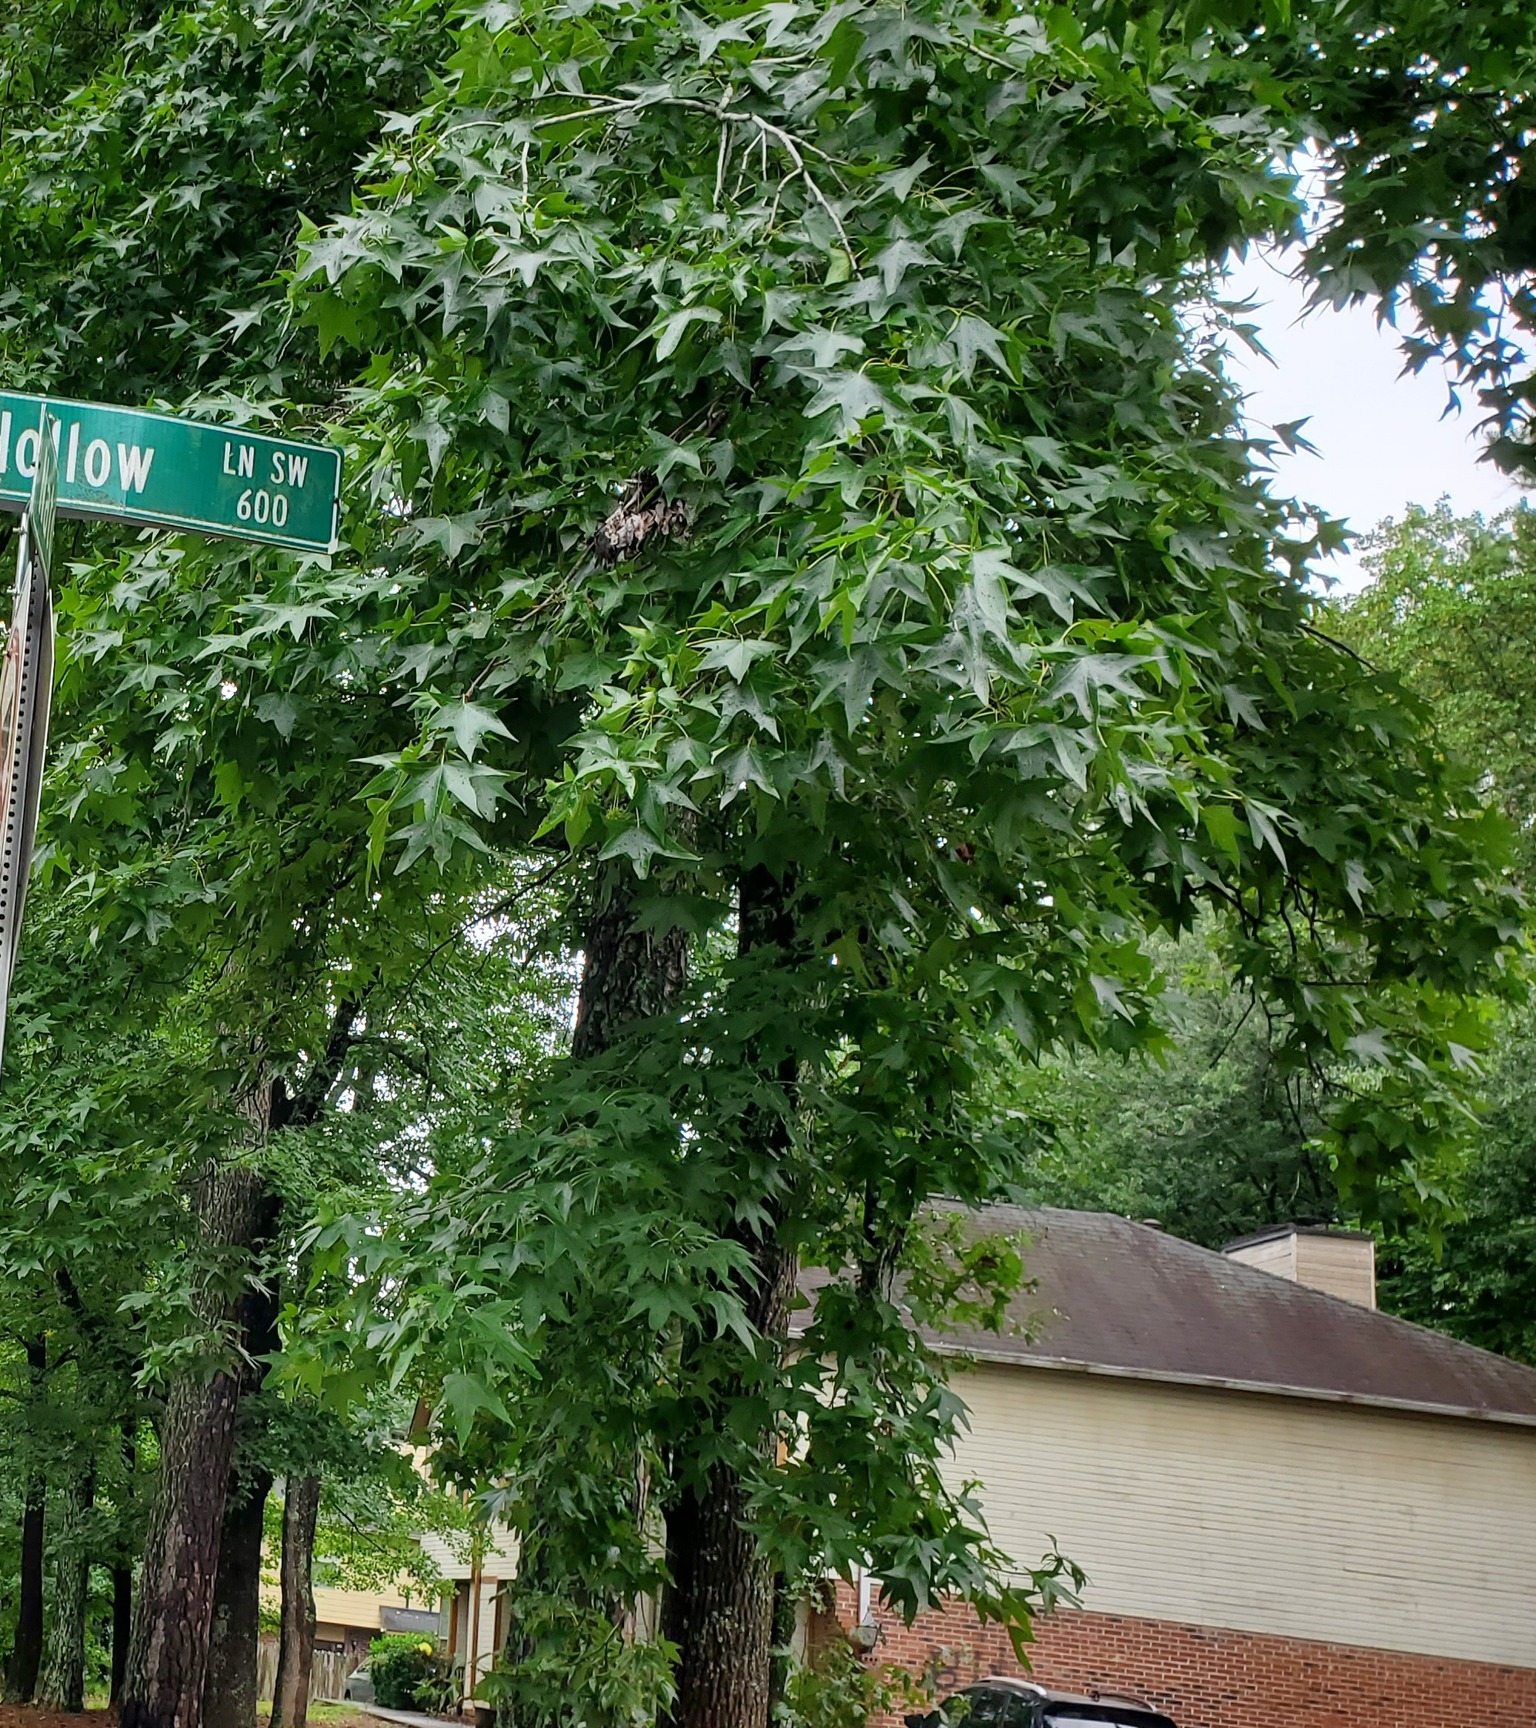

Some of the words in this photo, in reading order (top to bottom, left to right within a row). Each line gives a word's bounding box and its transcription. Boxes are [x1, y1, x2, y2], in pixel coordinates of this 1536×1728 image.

[223, 441, 255, 478] LN
[270, 451, 308, 488] SW
[236, 488, 288, 527] 600
